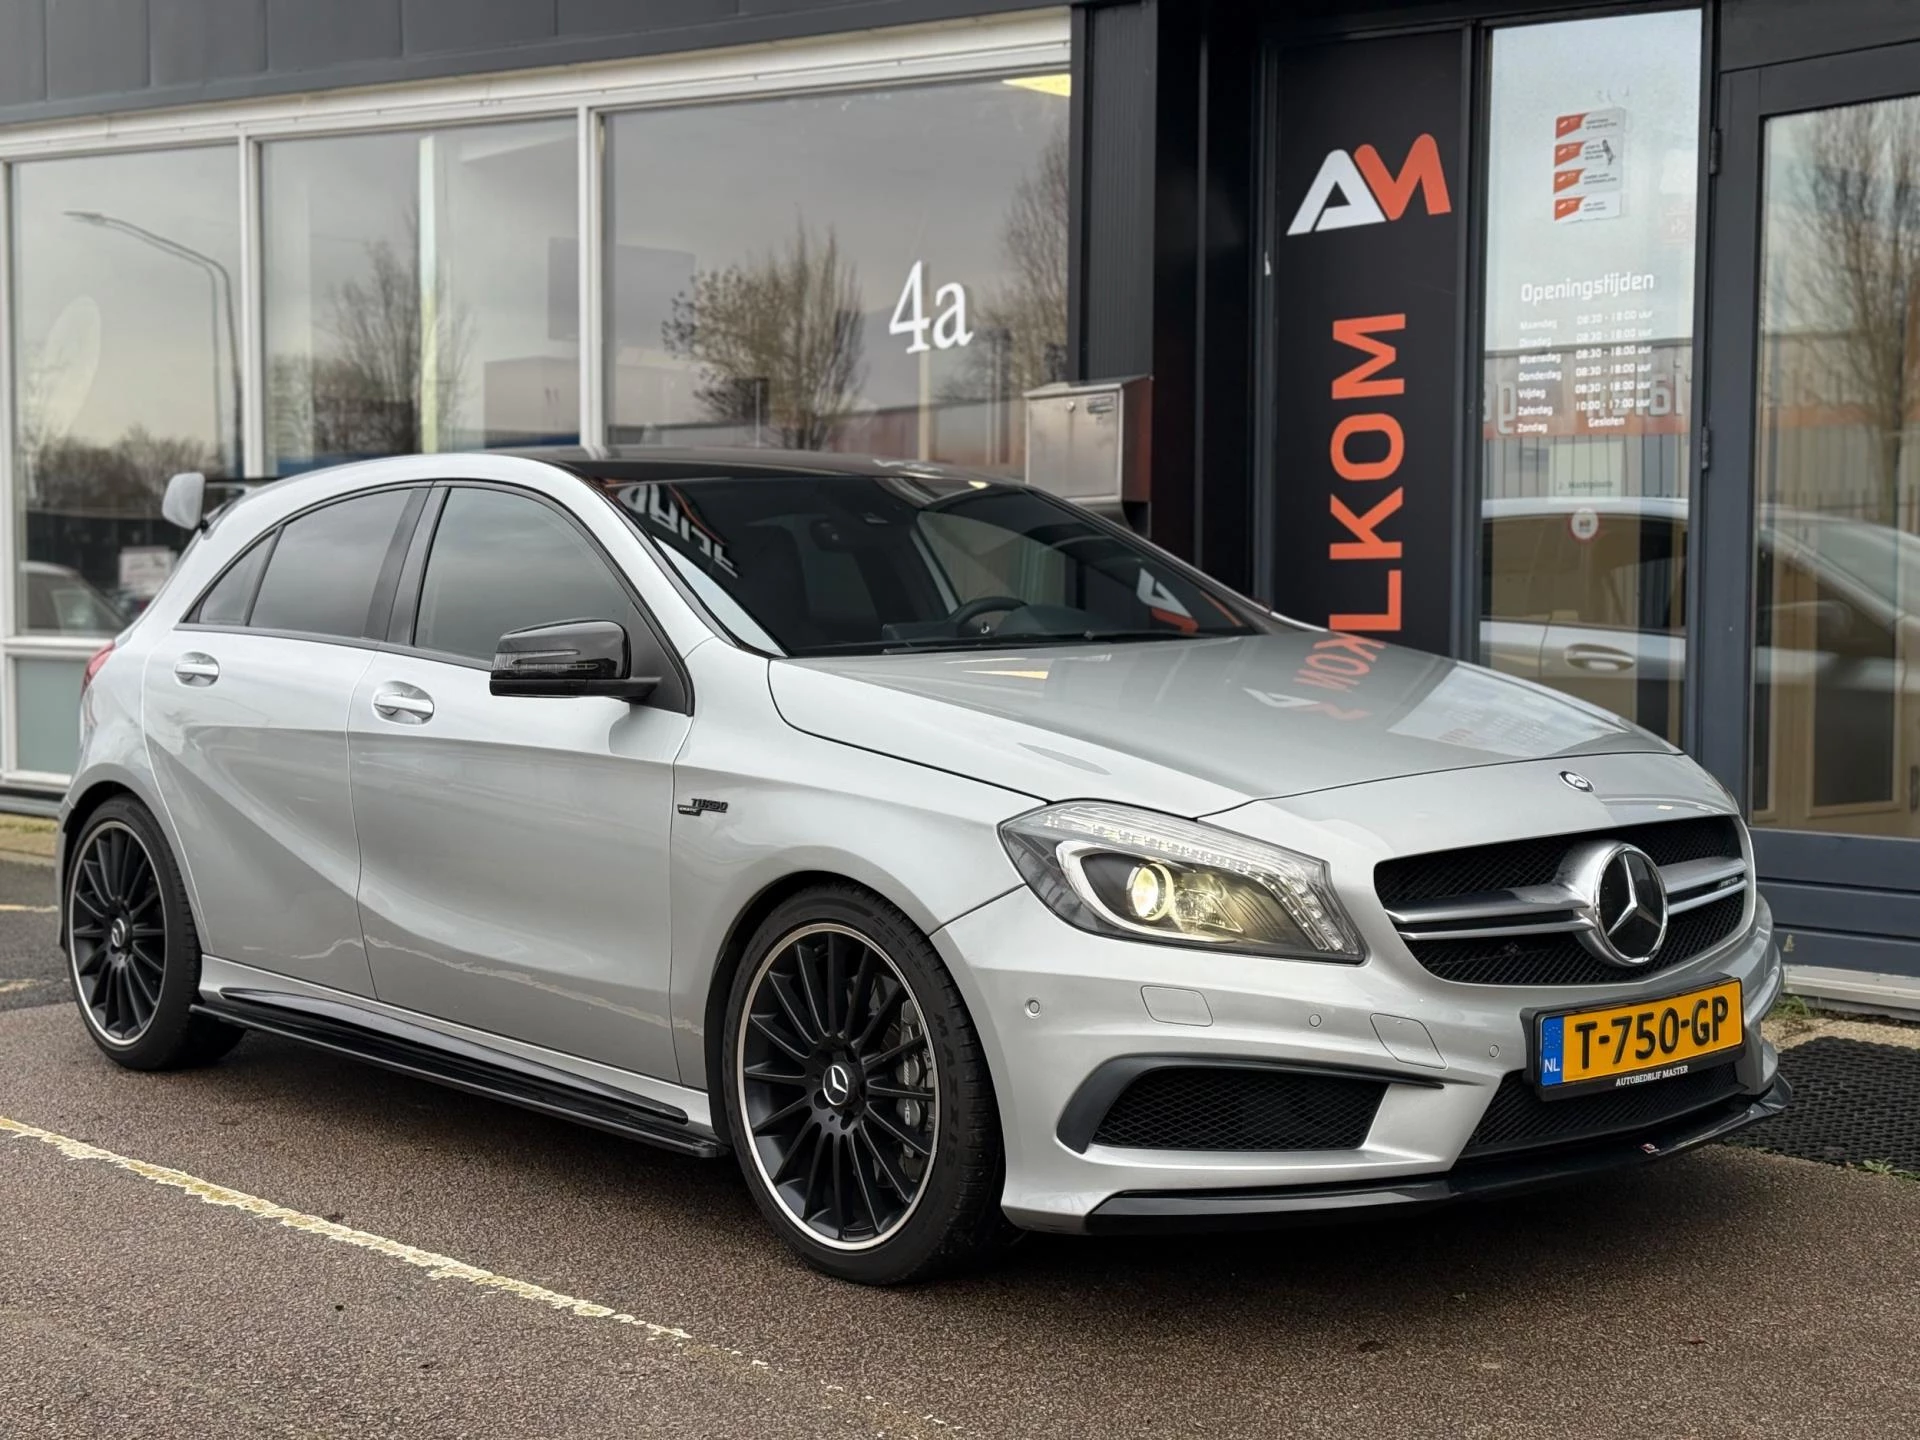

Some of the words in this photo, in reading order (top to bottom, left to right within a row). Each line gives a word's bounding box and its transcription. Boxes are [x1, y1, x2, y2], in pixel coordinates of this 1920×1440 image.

[1521, 272, 1655, 305] Openingstijden
[888, 259, 975, 355] 4a
[1519, 353, 1562, 365] Woensdag
[1575, 348, 1601, 360] 08:30
[1610, 345, 1636, 357] 18:00
[1638, 345, 1652, 354] uur
[1518, 370, 1562, 382] Donderdag
[1575, 364, 1601, 377] 08:30
[1610, 362, 1636, 374] 18:00
[1637, 362, 1652, 372] uur
[1637, 379, 1652, 389] uur
[1636, 397, 1651, 408] uur
[1517, 422, 1548, 434] Zondag
[1588, 416, 1625, 428] Gesloten
[1328, 313, 1406, 632] LKOM
[1575, 996, 1729, 1070] T-750-GP
[1543, 1057, 1561, 1074] NL
[1615, 1070, 1662, 1088] AUTOBEDRIJF
[1662, 1064, 1689, 1080] MASTER
